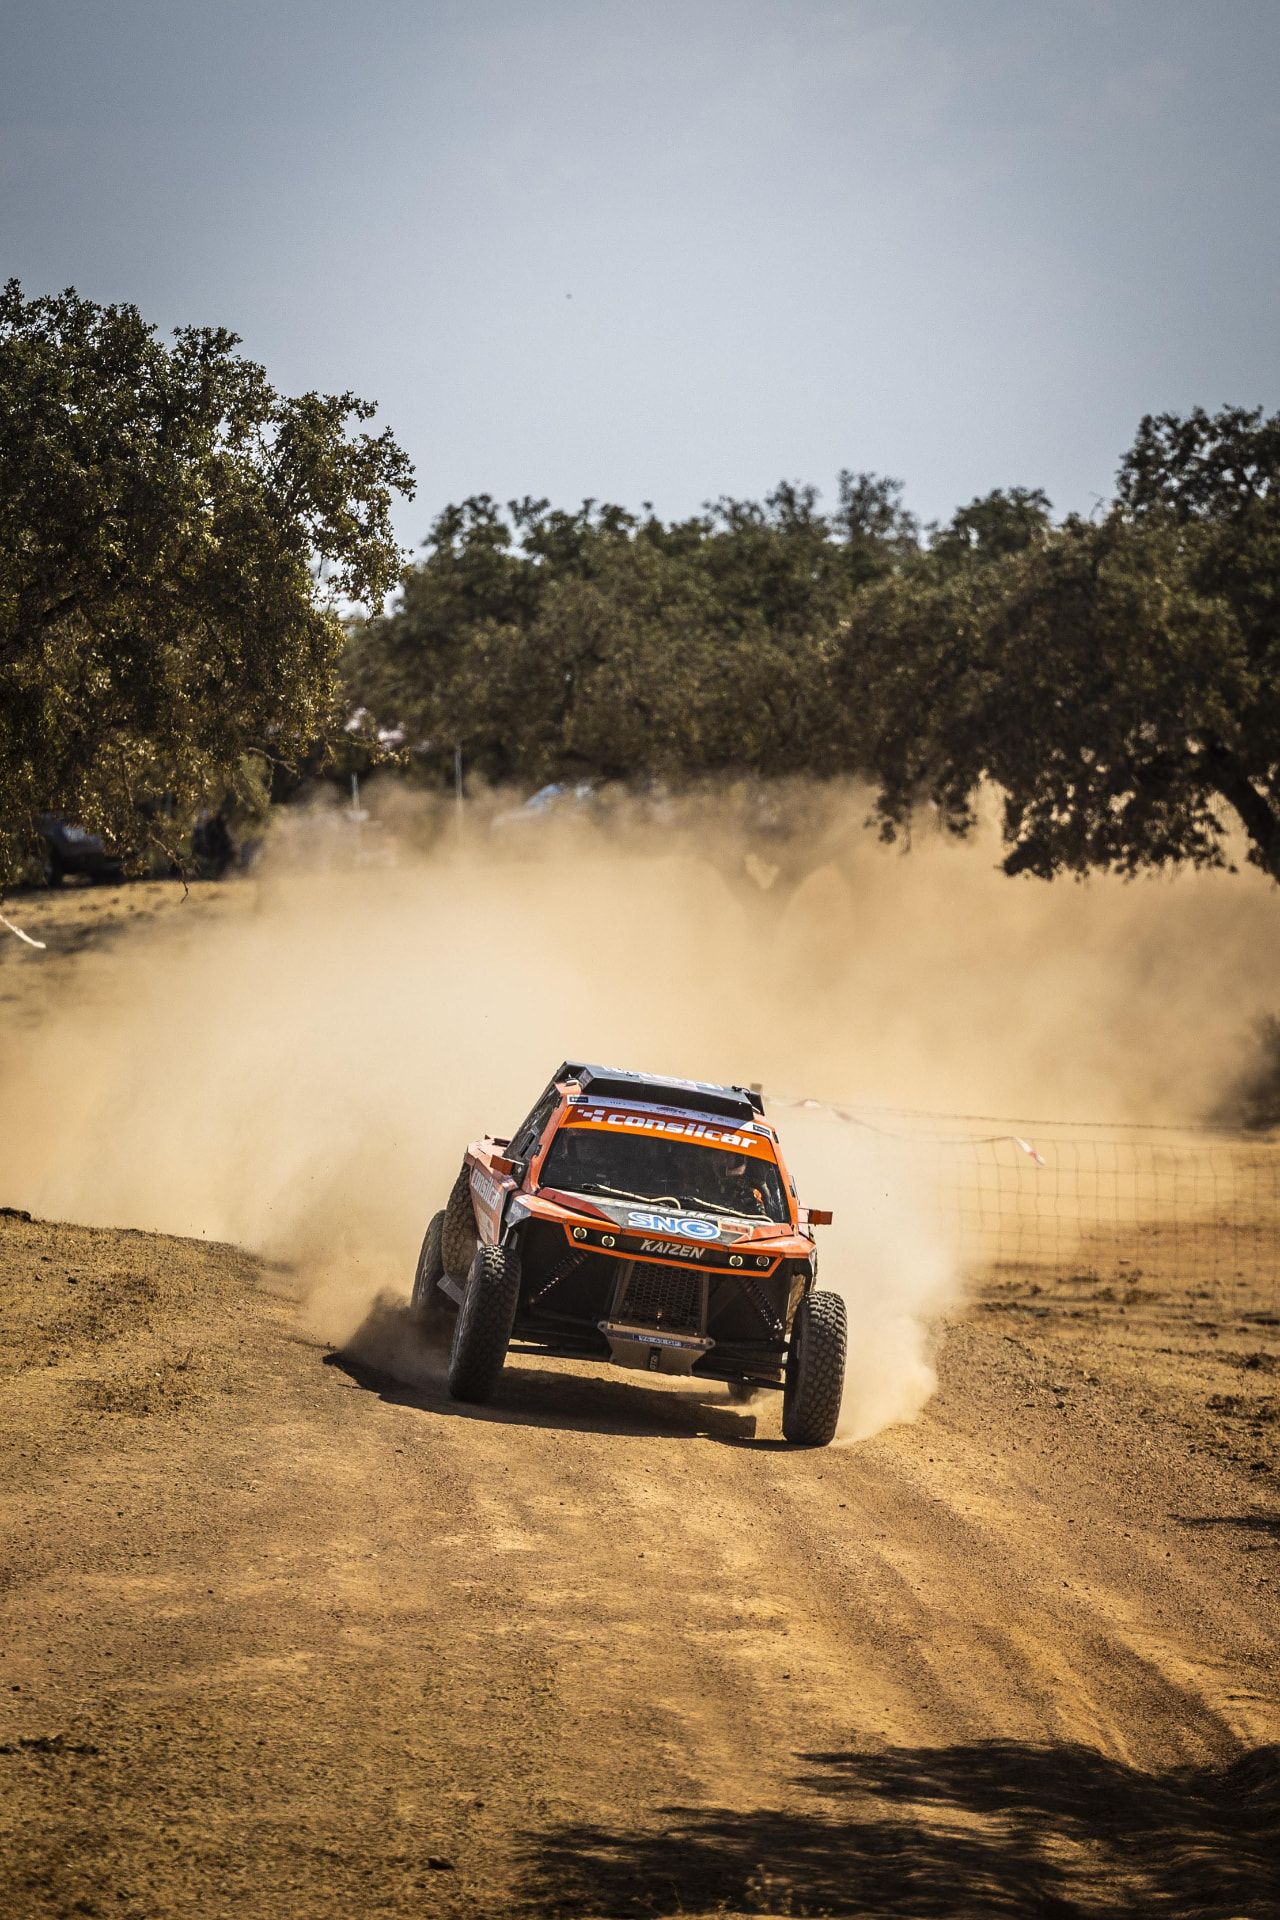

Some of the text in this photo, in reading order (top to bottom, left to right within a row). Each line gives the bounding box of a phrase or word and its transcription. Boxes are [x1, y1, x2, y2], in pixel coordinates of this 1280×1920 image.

[607, 1114, 757, 1148] consilcar
[628, 1211, 721, 1239] SNG
[640, 1239, 705, 1259] KAIZEN
